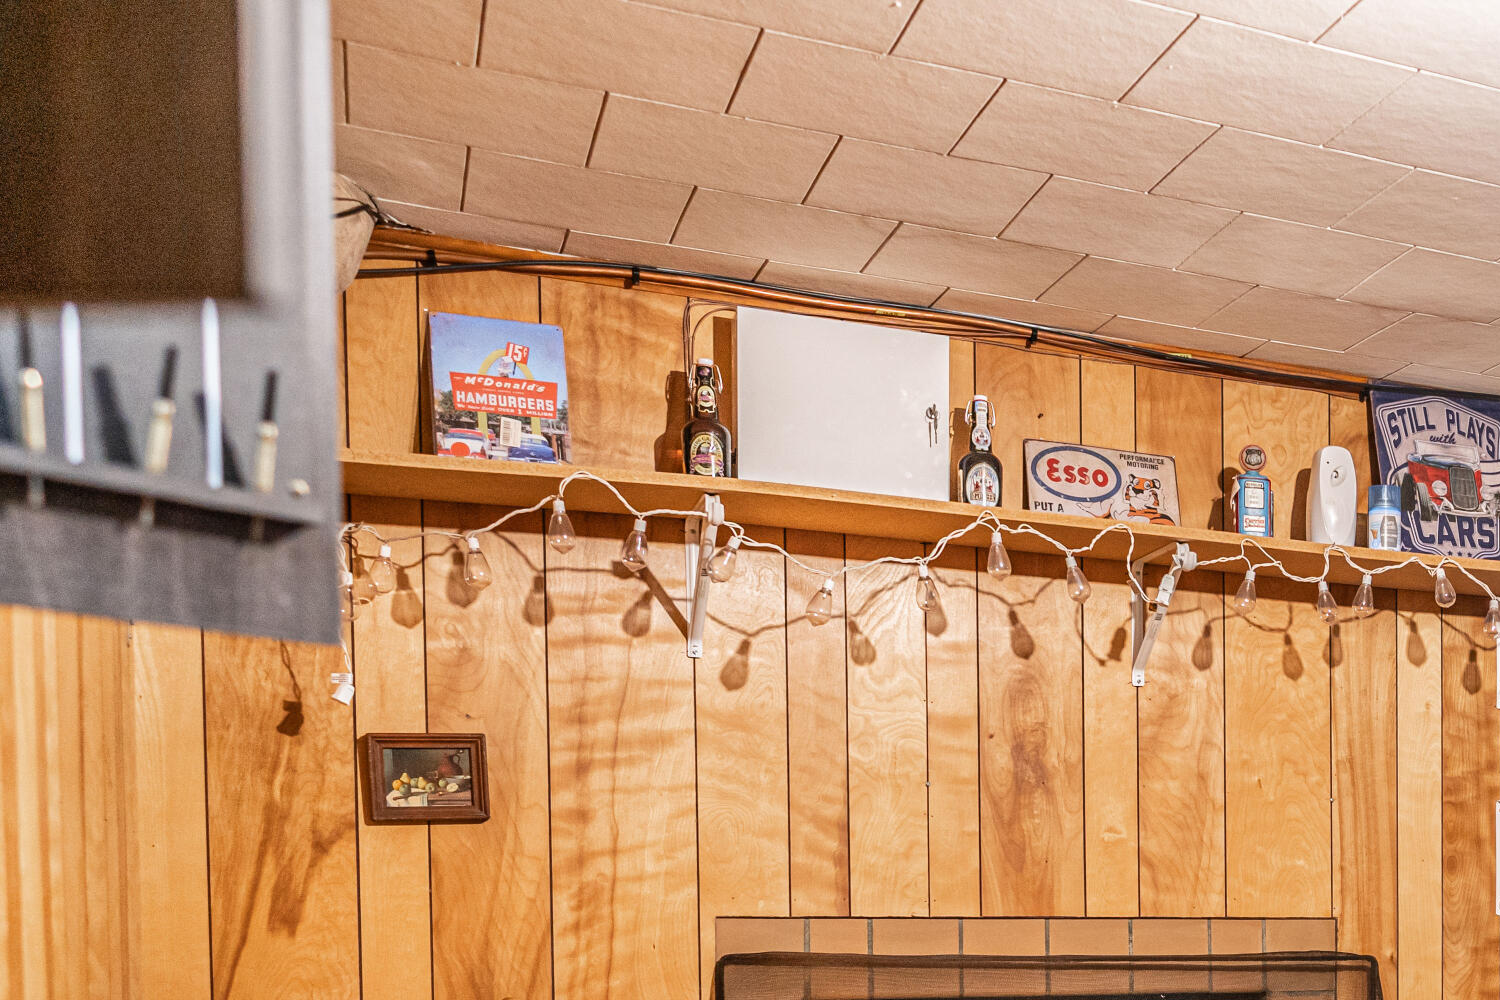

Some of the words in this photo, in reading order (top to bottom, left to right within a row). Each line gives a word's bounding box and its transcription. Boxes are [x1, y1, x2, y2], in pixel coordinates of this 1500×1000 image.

[464, 376, 546, 393] McDonald's
[456, 390, 554, 412] HAMBURGERS
[1387, 406, 1436, 449] STILL
[1445, 408, 1496, 460] PLAYS
[1429, 432, 1457, 445] with
[1034, 501, 1053, 512] PUT
[1057, 504, 1064, 512] A
[1414, 511, 1495, 549] CARS
